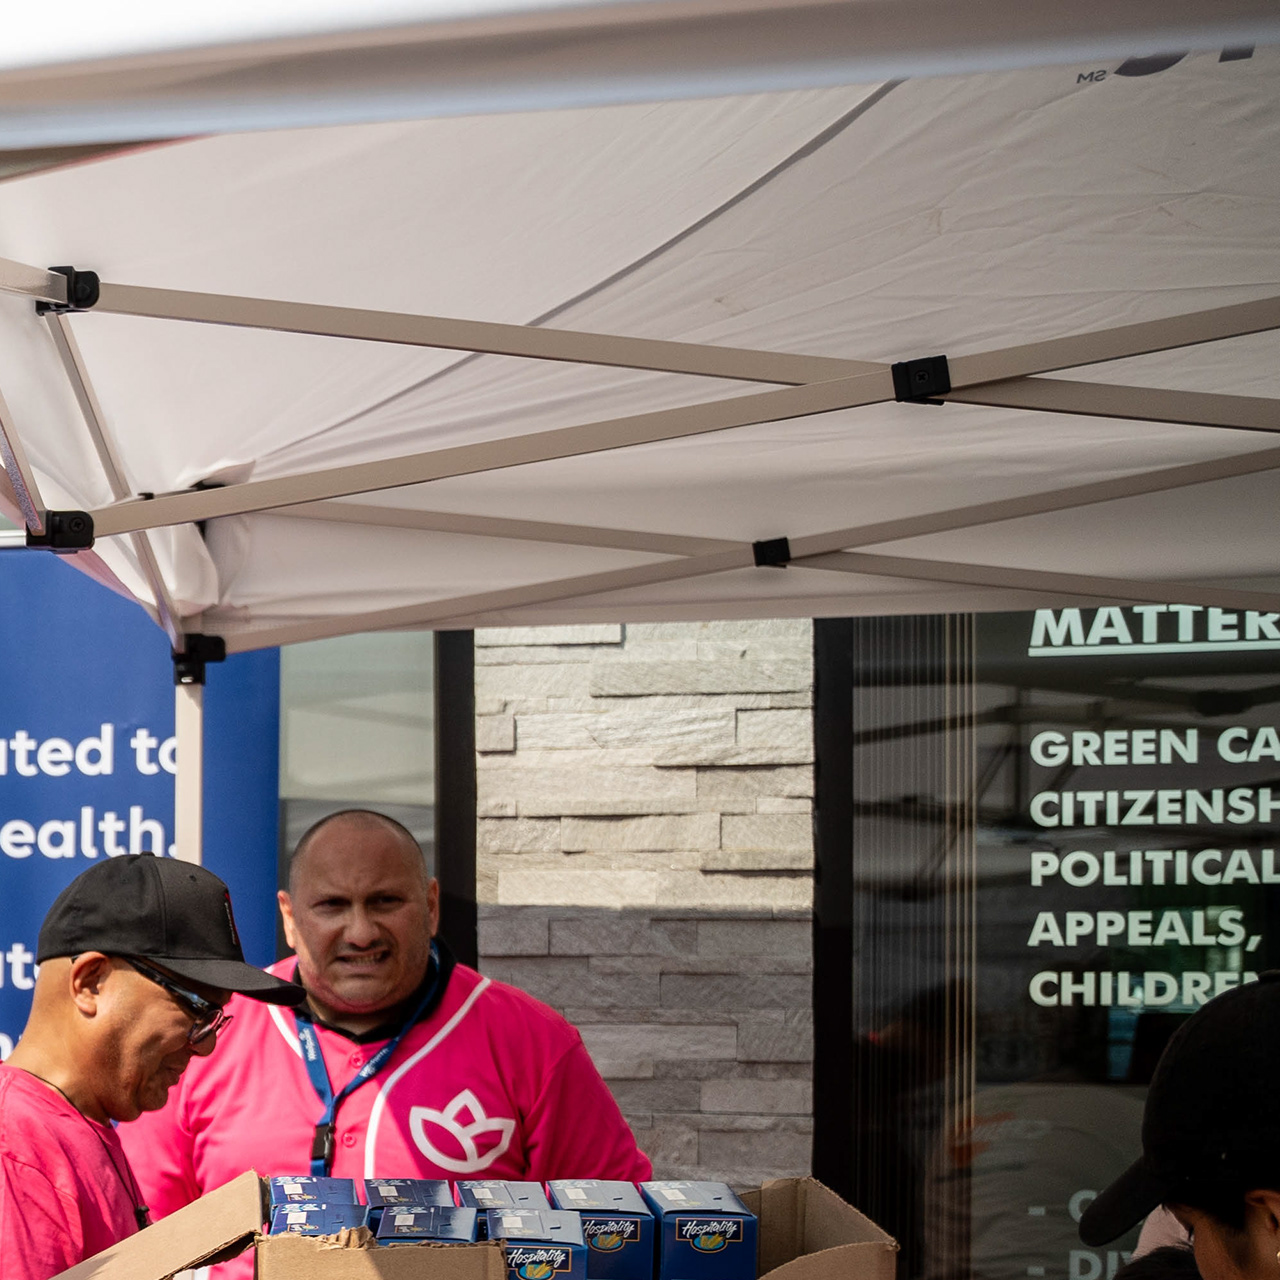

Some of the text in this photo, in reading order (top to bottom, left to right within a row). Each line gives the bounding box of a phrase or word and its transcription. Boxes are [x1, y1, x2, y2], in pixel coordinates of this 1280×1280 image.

[130, 728, 178, 776] to
[1030, 728, 1198, 768] GREEN
[1030, 848, 1280, 887] POLITICAL
[1027, 910, 1262, 952] APPEALS,
[1028, 970, 1259, 1007] CHILDRE
[583, 1219, 636, 1239] Hospitality
[682, 1219, 738, 1239] Hospitality
[507, 1248, 567, 1268] Hospitality
